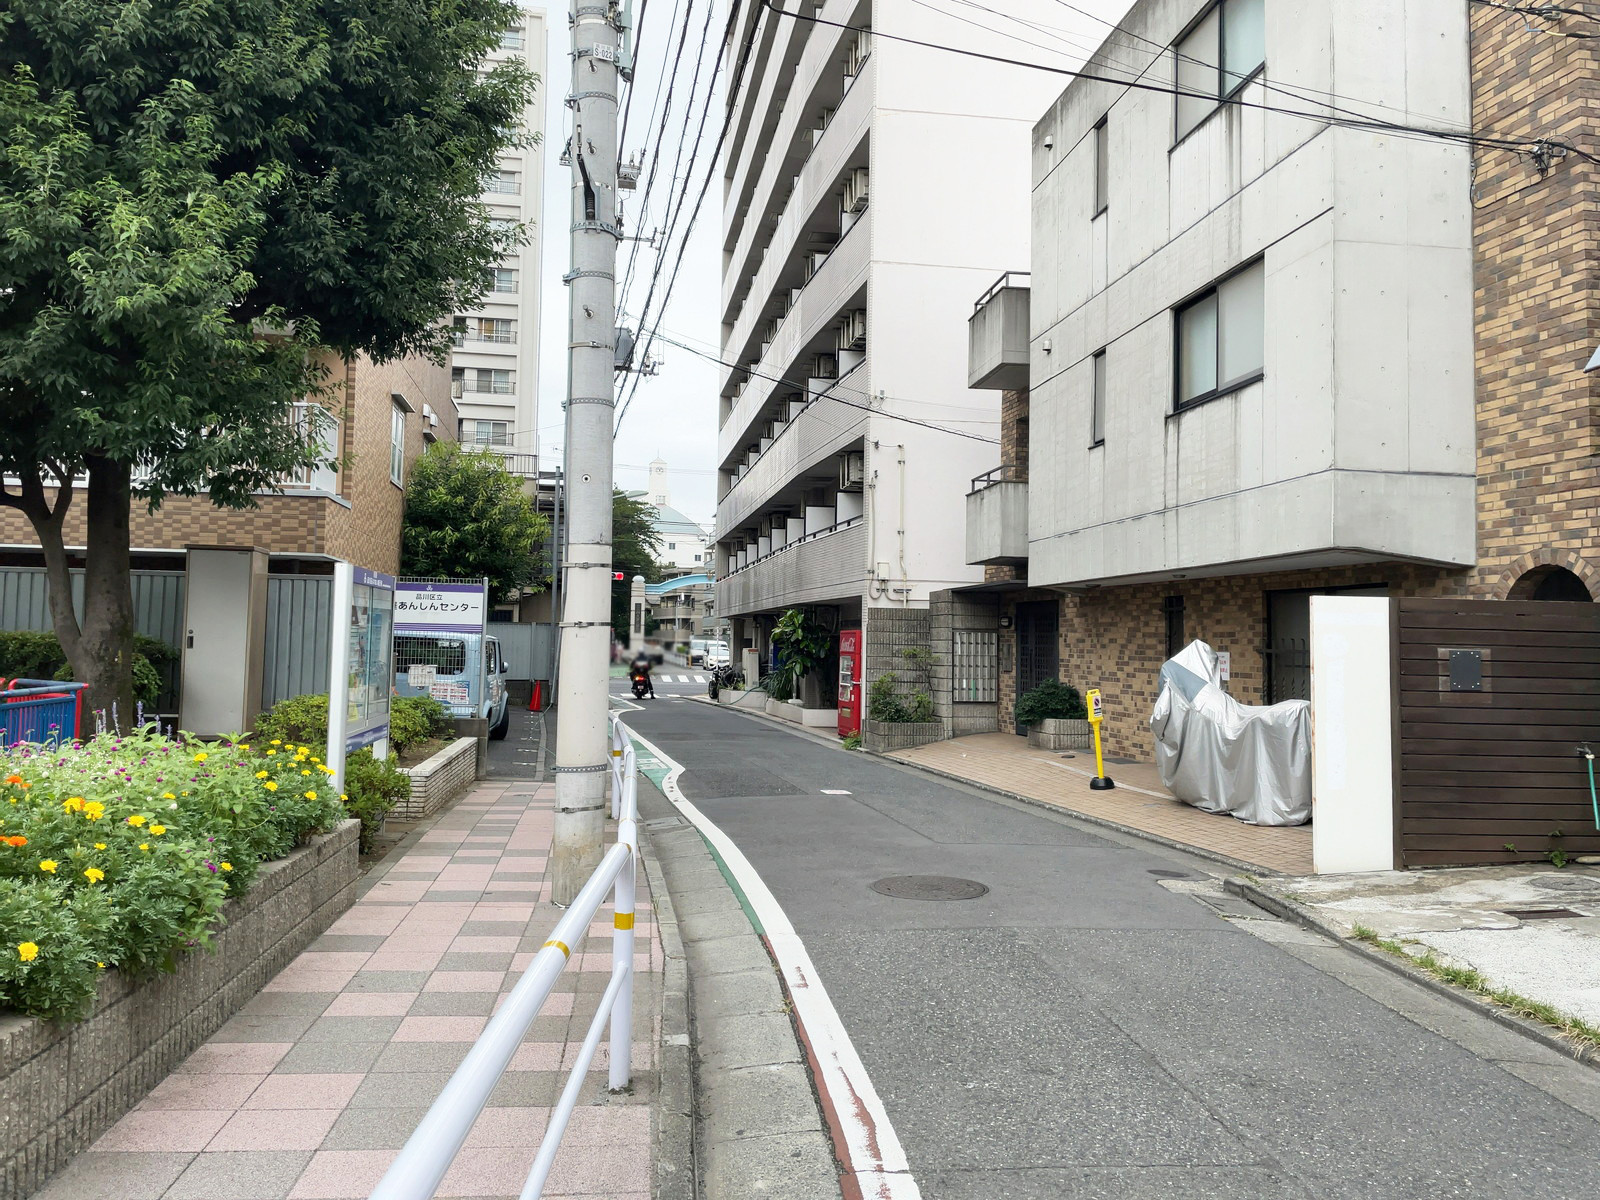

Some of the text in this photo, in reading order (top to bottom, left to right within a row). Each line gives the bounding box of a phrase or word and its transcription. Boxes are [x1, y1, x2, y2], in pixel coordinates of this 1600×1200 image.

[416, 593, 443, 601] 品川区立
[395, 601, 479, 612] あんしんセンター
